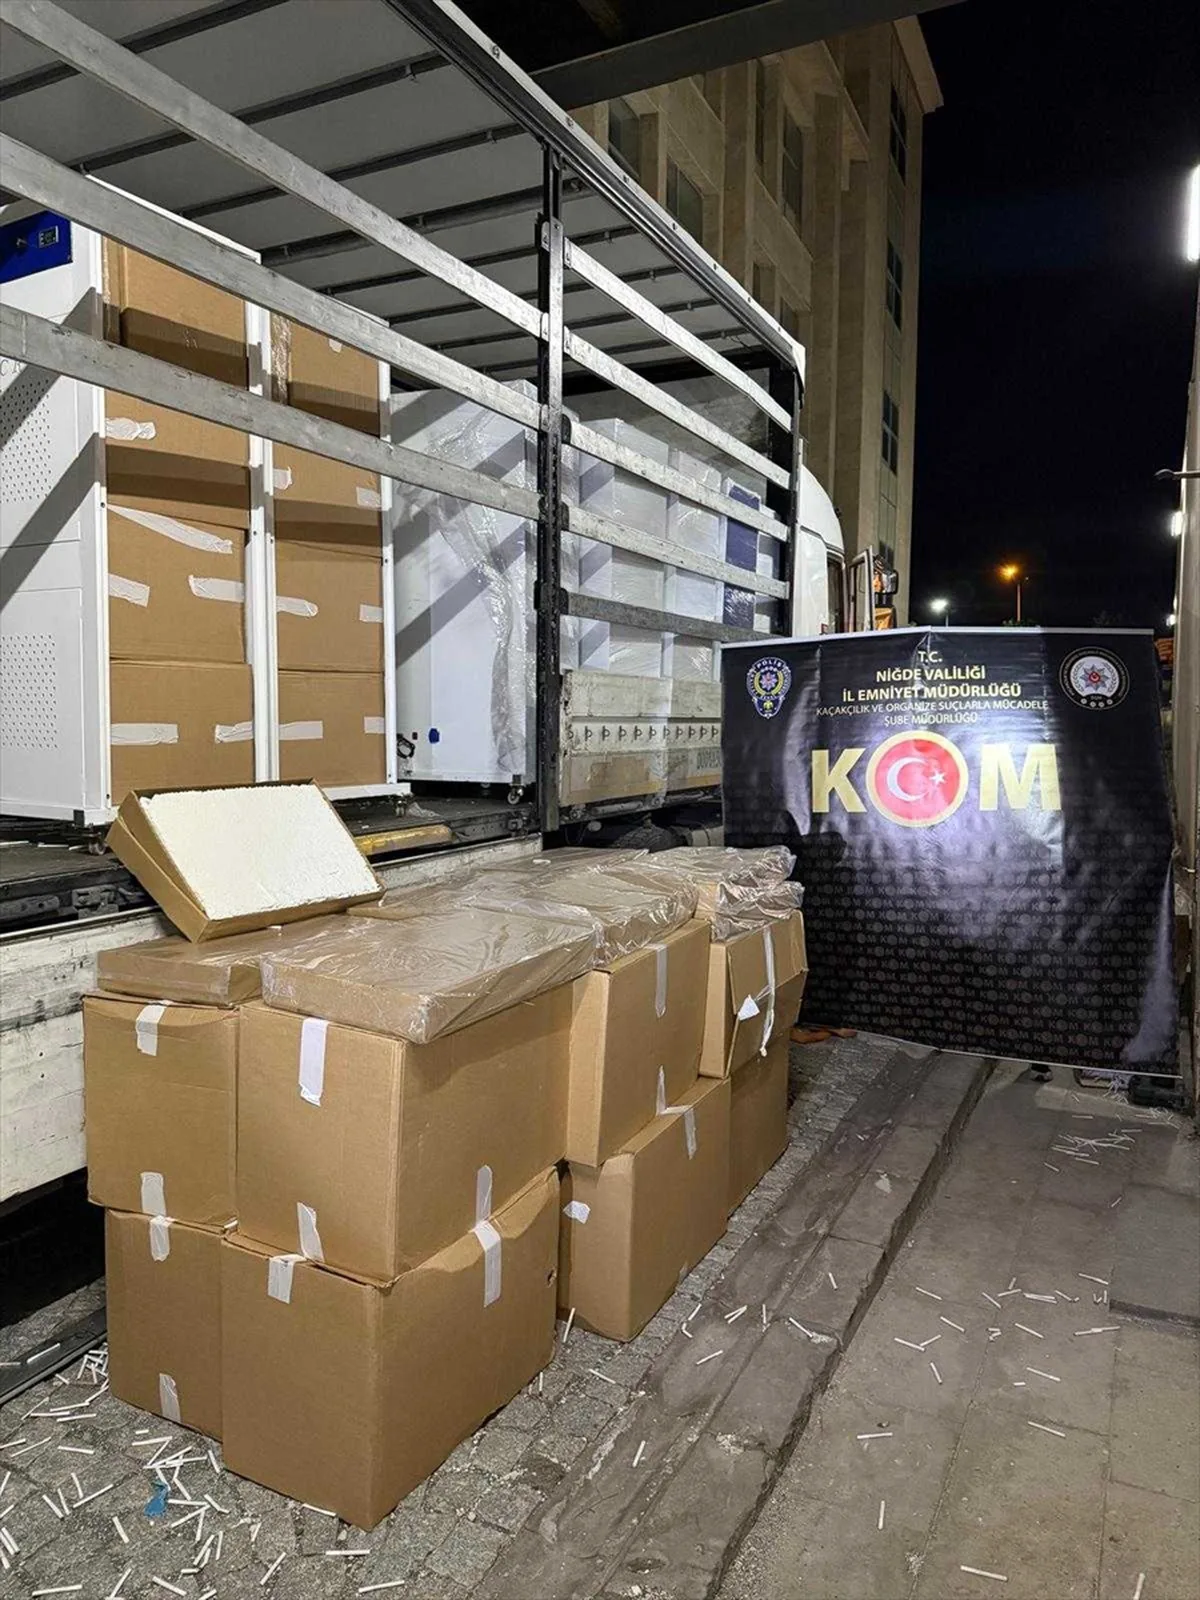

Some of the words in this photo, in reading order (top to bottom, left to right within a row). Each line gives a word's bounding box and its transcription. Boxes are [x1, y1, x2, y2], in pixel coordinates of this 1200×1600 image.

[918, 650, 942, 663] T.C.
[876, 666, 922, 682] NİĞDE
[924, 664, 986, 680] VALİLİĞİ
[842, 687, 855, 702] İL
[857, 685, 920, 701] EMNİYET
[923, 682, 1022, 698] MÜDÜRLÜĞÜ
[816, 705, 870, 718] KAÇAKÇILIK
[872, 704, 884, 713] VE
[939, 700, 992, 712] SUÇLARLA
[992, 698, 1048, 710] MÜCADELE
[884, 715, 910, 728] ŞUBE
[911, 711, 978, 724] MÜDÜRLÜĞÜ
